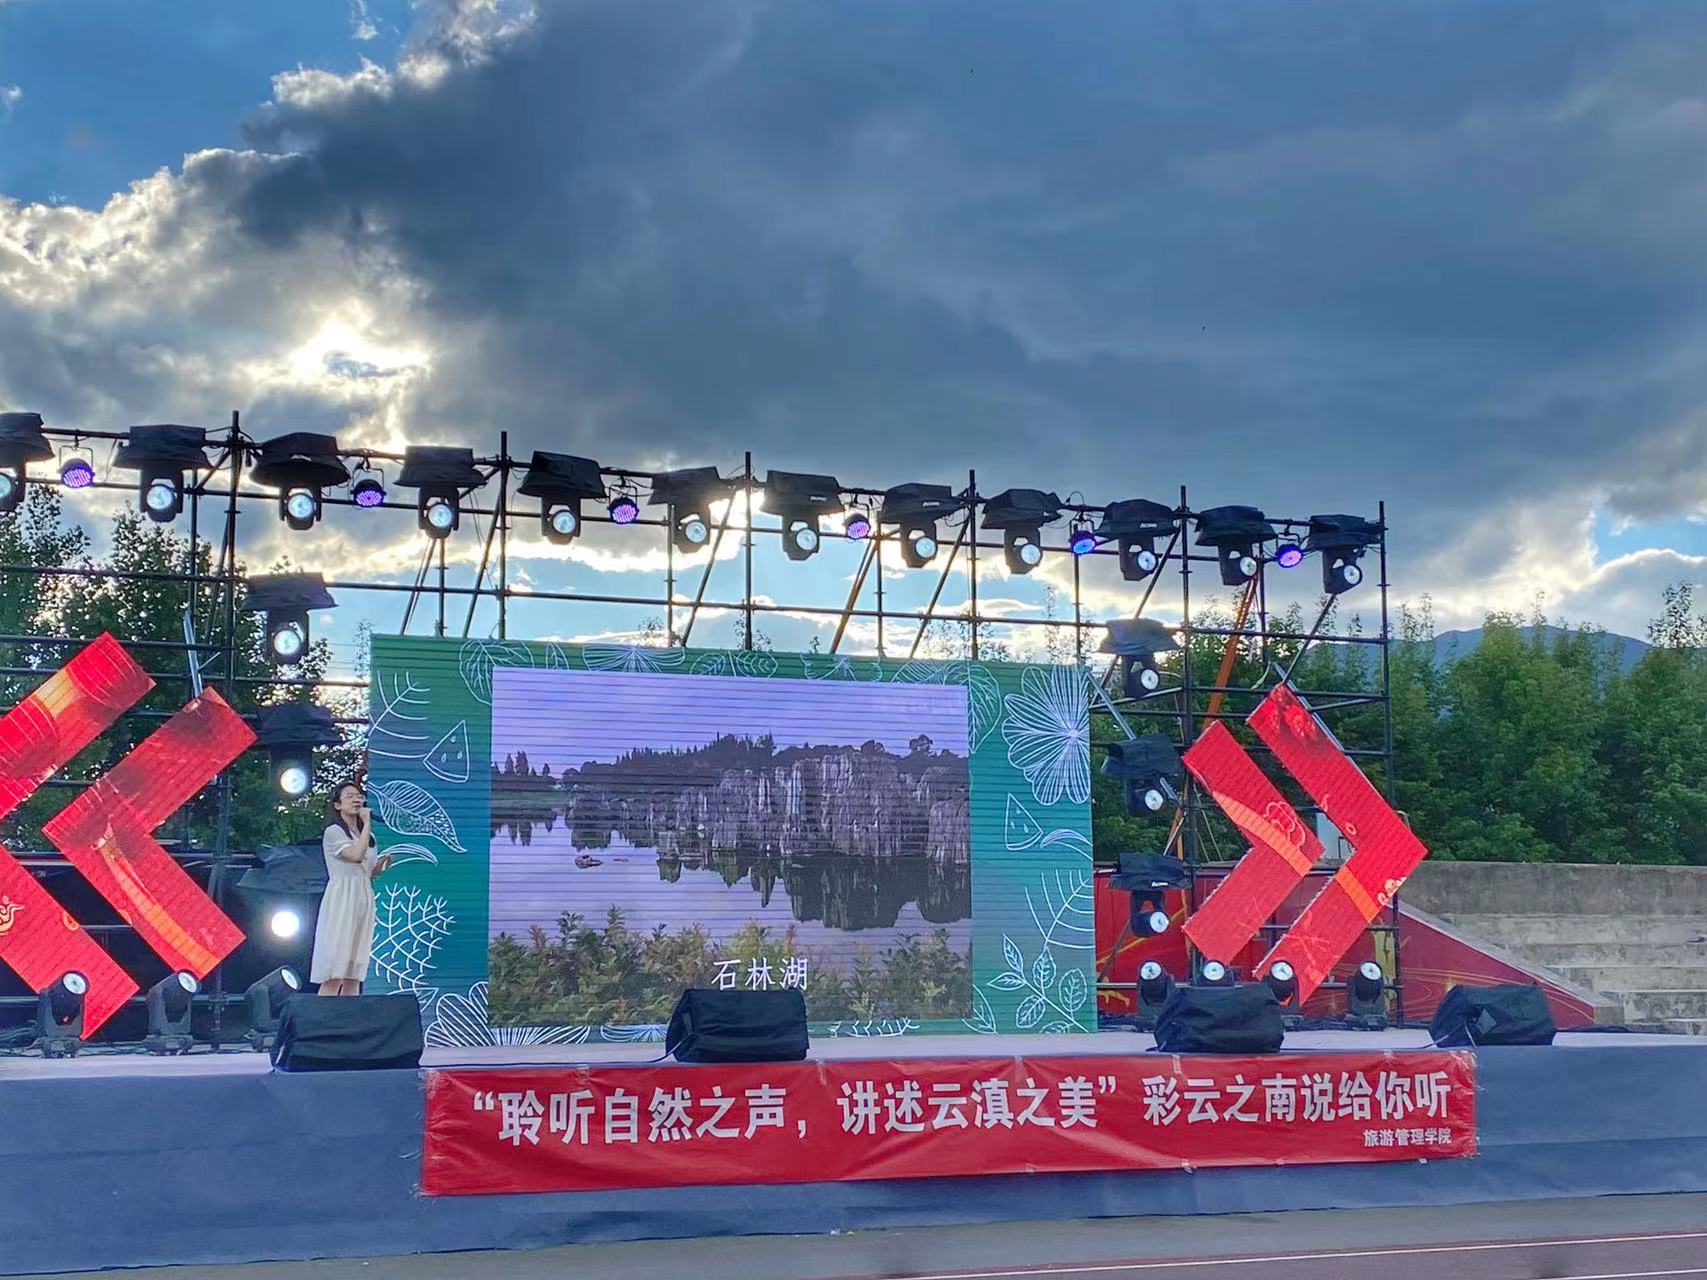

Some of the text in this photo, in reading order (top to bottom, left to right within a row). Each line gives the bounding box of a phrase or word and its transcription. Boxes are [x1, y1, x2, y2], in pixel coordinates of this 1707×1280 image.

[711, 957, 808, 991] 石林湖
[1143, 1071, 1452, 1125] 彩云之南说给你听
[1363, 1127, 1452, 1147] 旅游管理学院
